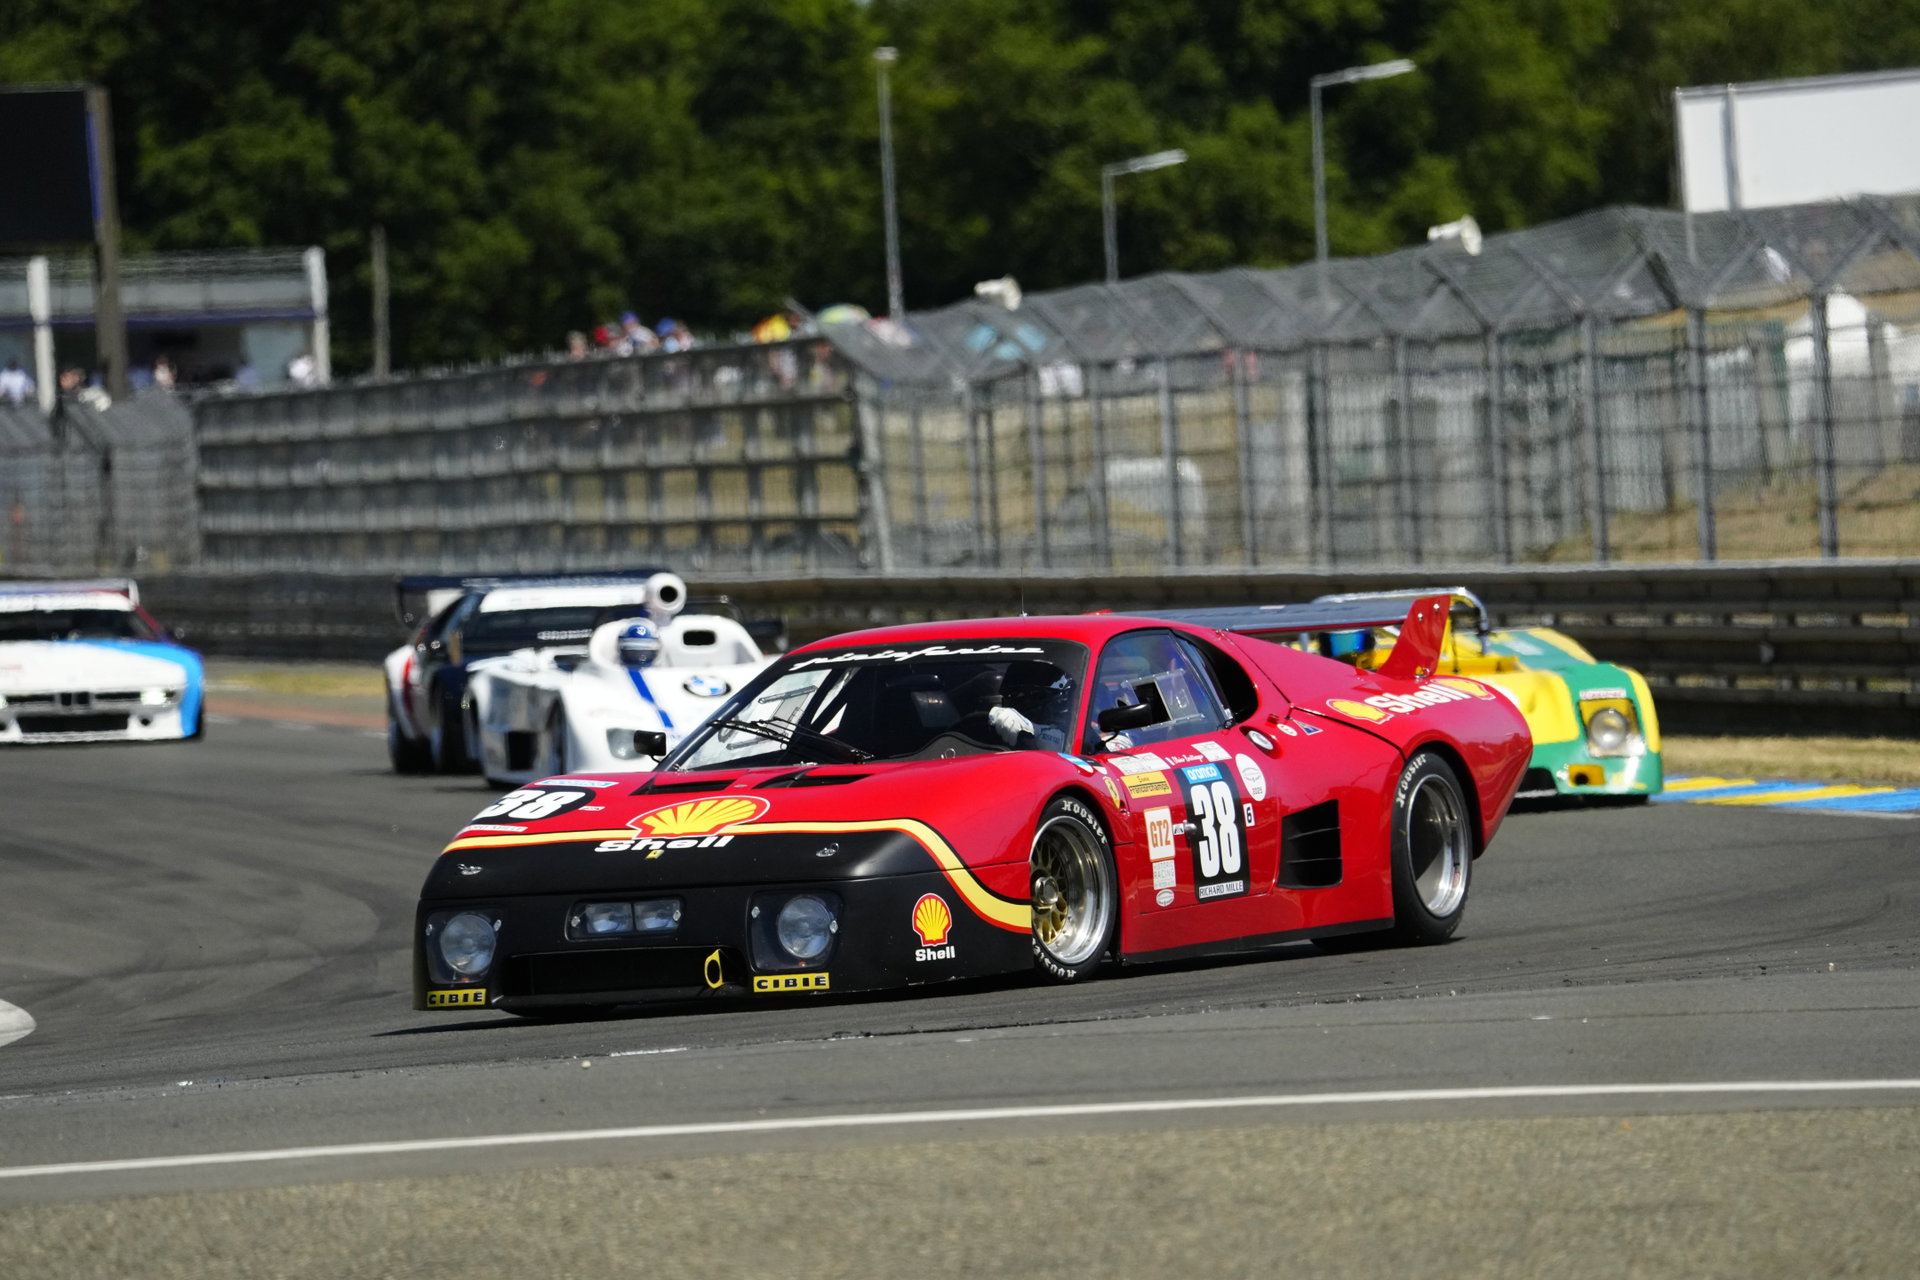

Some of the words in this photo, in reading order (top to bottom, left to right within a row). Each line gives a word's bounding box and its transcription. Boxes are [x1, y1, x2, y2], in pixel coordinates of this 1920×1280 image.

[1363, 683, 1472, 713] Shell
[1186, 765, 1218, 780] aramco
[471, 789, 586, 820] 38
[1246, 806, 1253, 824] 6
[1150, 819, 1171, 849] GT2
[1190, 780, 1242, 878] 38
[594, 835, 735, 852] Shell
[1200, 884, 1225, 897] RICHARD
[1226, 881, 1243, 892] MILLE
[915, 946, 956, 962] Shell
[756, 975, 827, 990] CIBIE
[429, 991, 483, 1005] CIBIE
